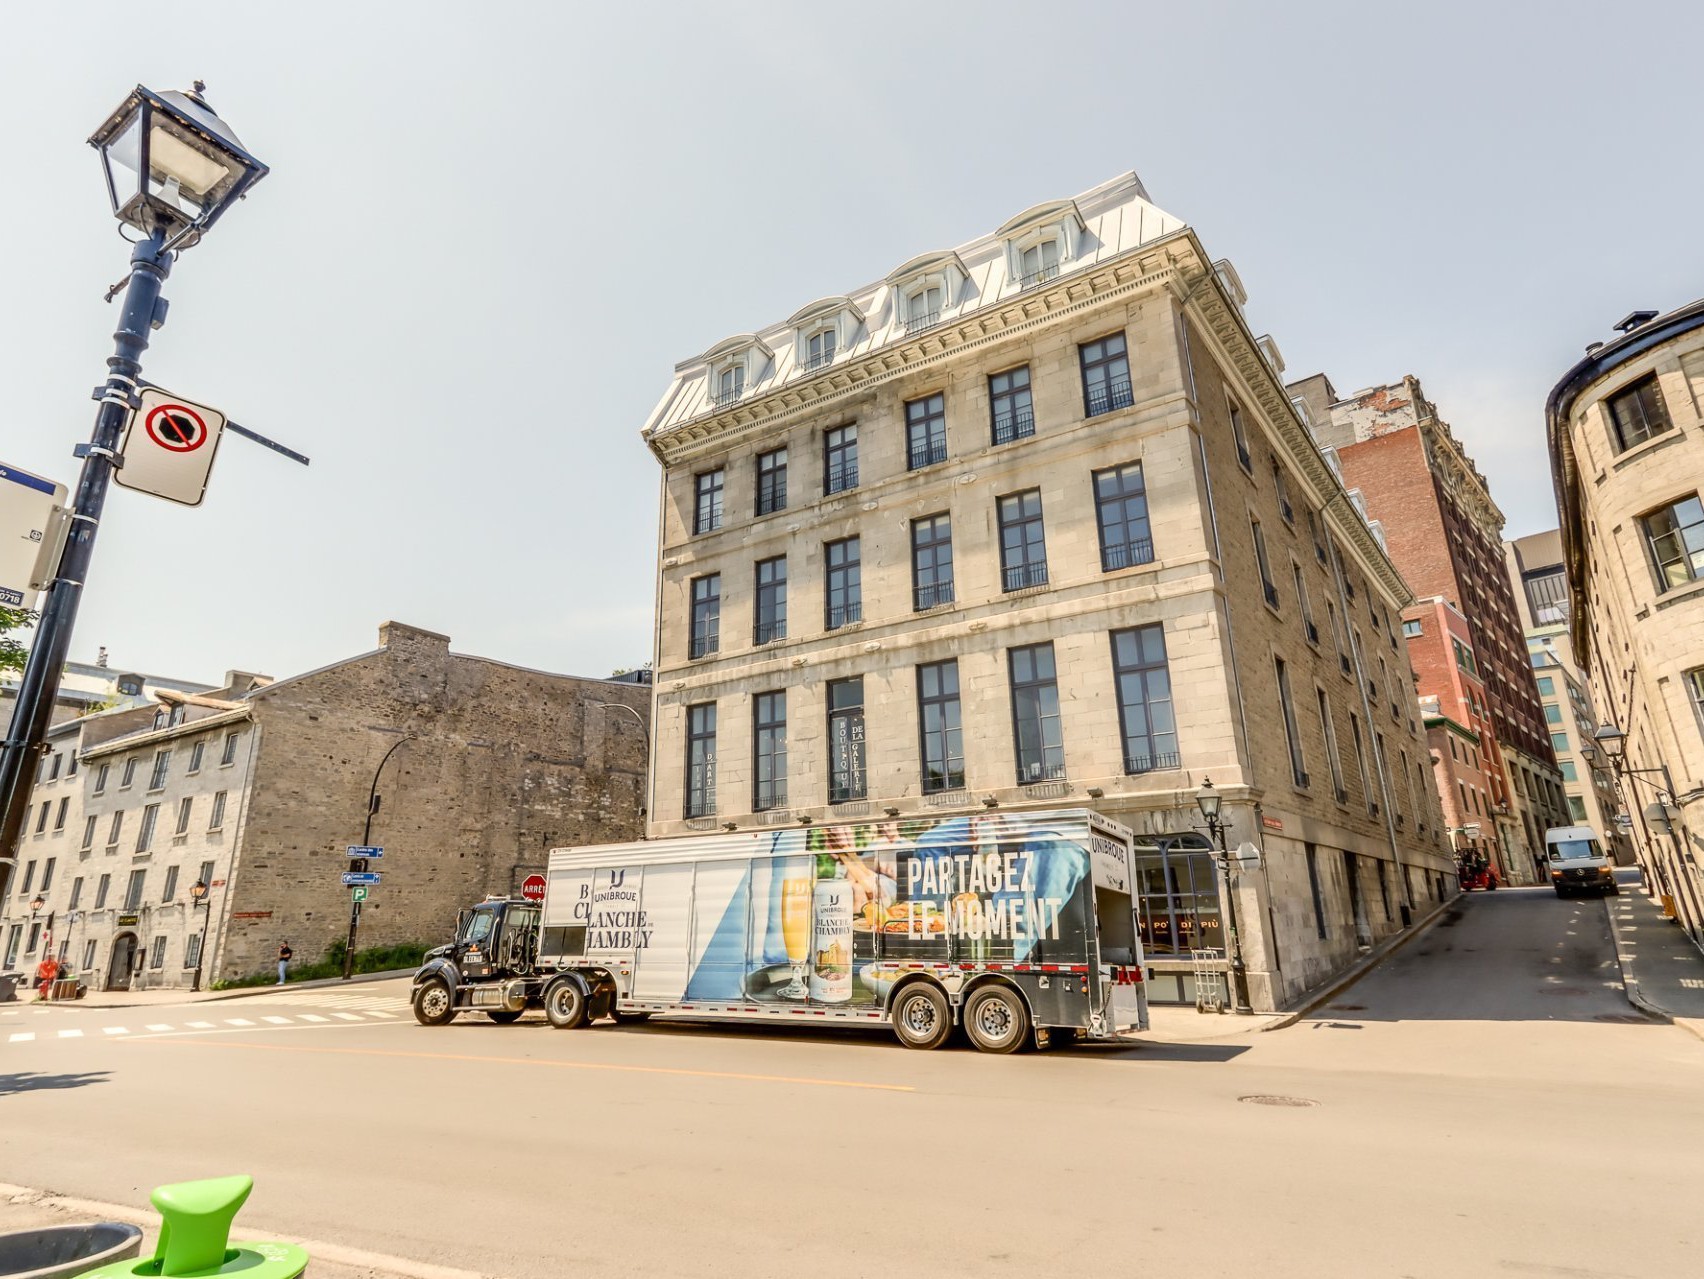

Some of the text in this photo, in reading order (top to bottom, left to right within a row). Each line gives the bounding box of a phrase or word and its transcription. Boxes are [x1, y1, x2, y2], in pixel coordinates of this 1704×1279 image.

[1092, 837, 1125, 864] UNIBROUE
[907, 851, 1036, 896] PARTAGEZ
[594, 891, 637, 903] UNIBROUE
[908, 900, 937, 941] LE
[944, 897, 1063, 941] MOMENT
